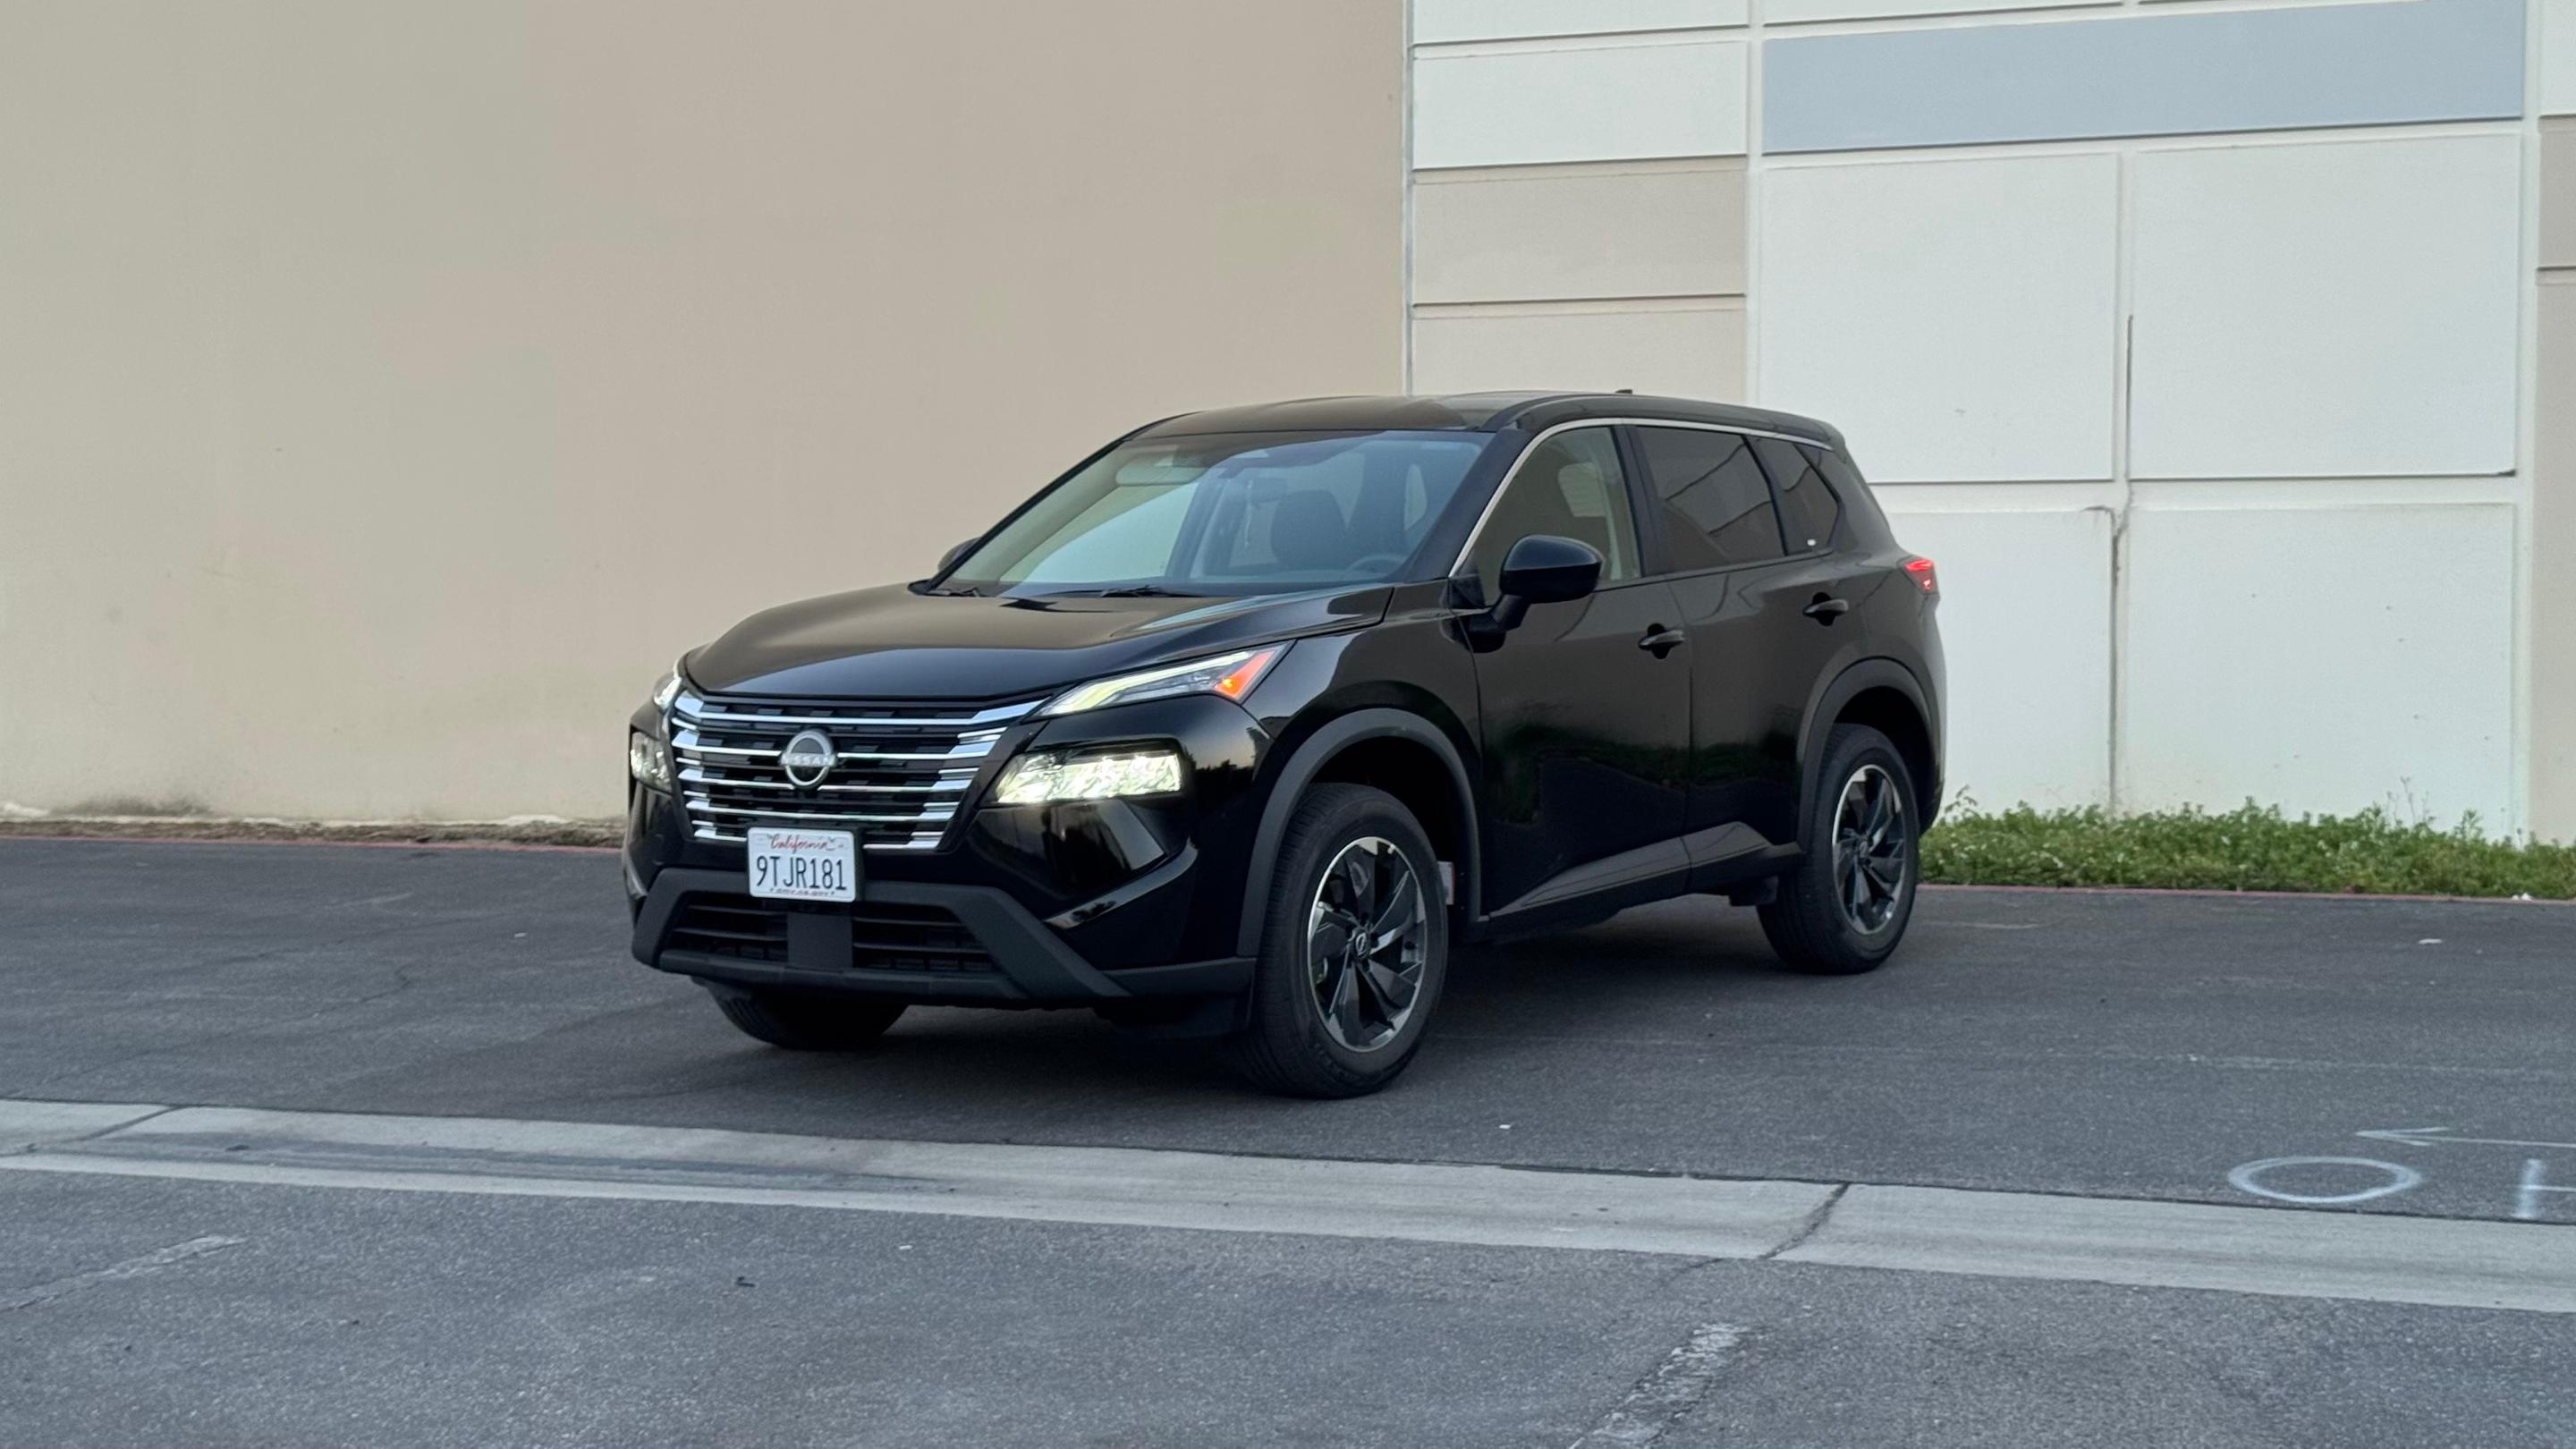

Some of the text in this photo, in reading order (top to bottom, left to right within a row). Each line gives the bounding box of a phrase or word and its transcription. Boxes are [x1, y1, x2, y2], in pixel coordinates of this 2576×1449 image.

[781, 755, 835, 767] NISSAN
[771, 834, 831, 853] California
[757, 855, 847, 890] 9TJR181
